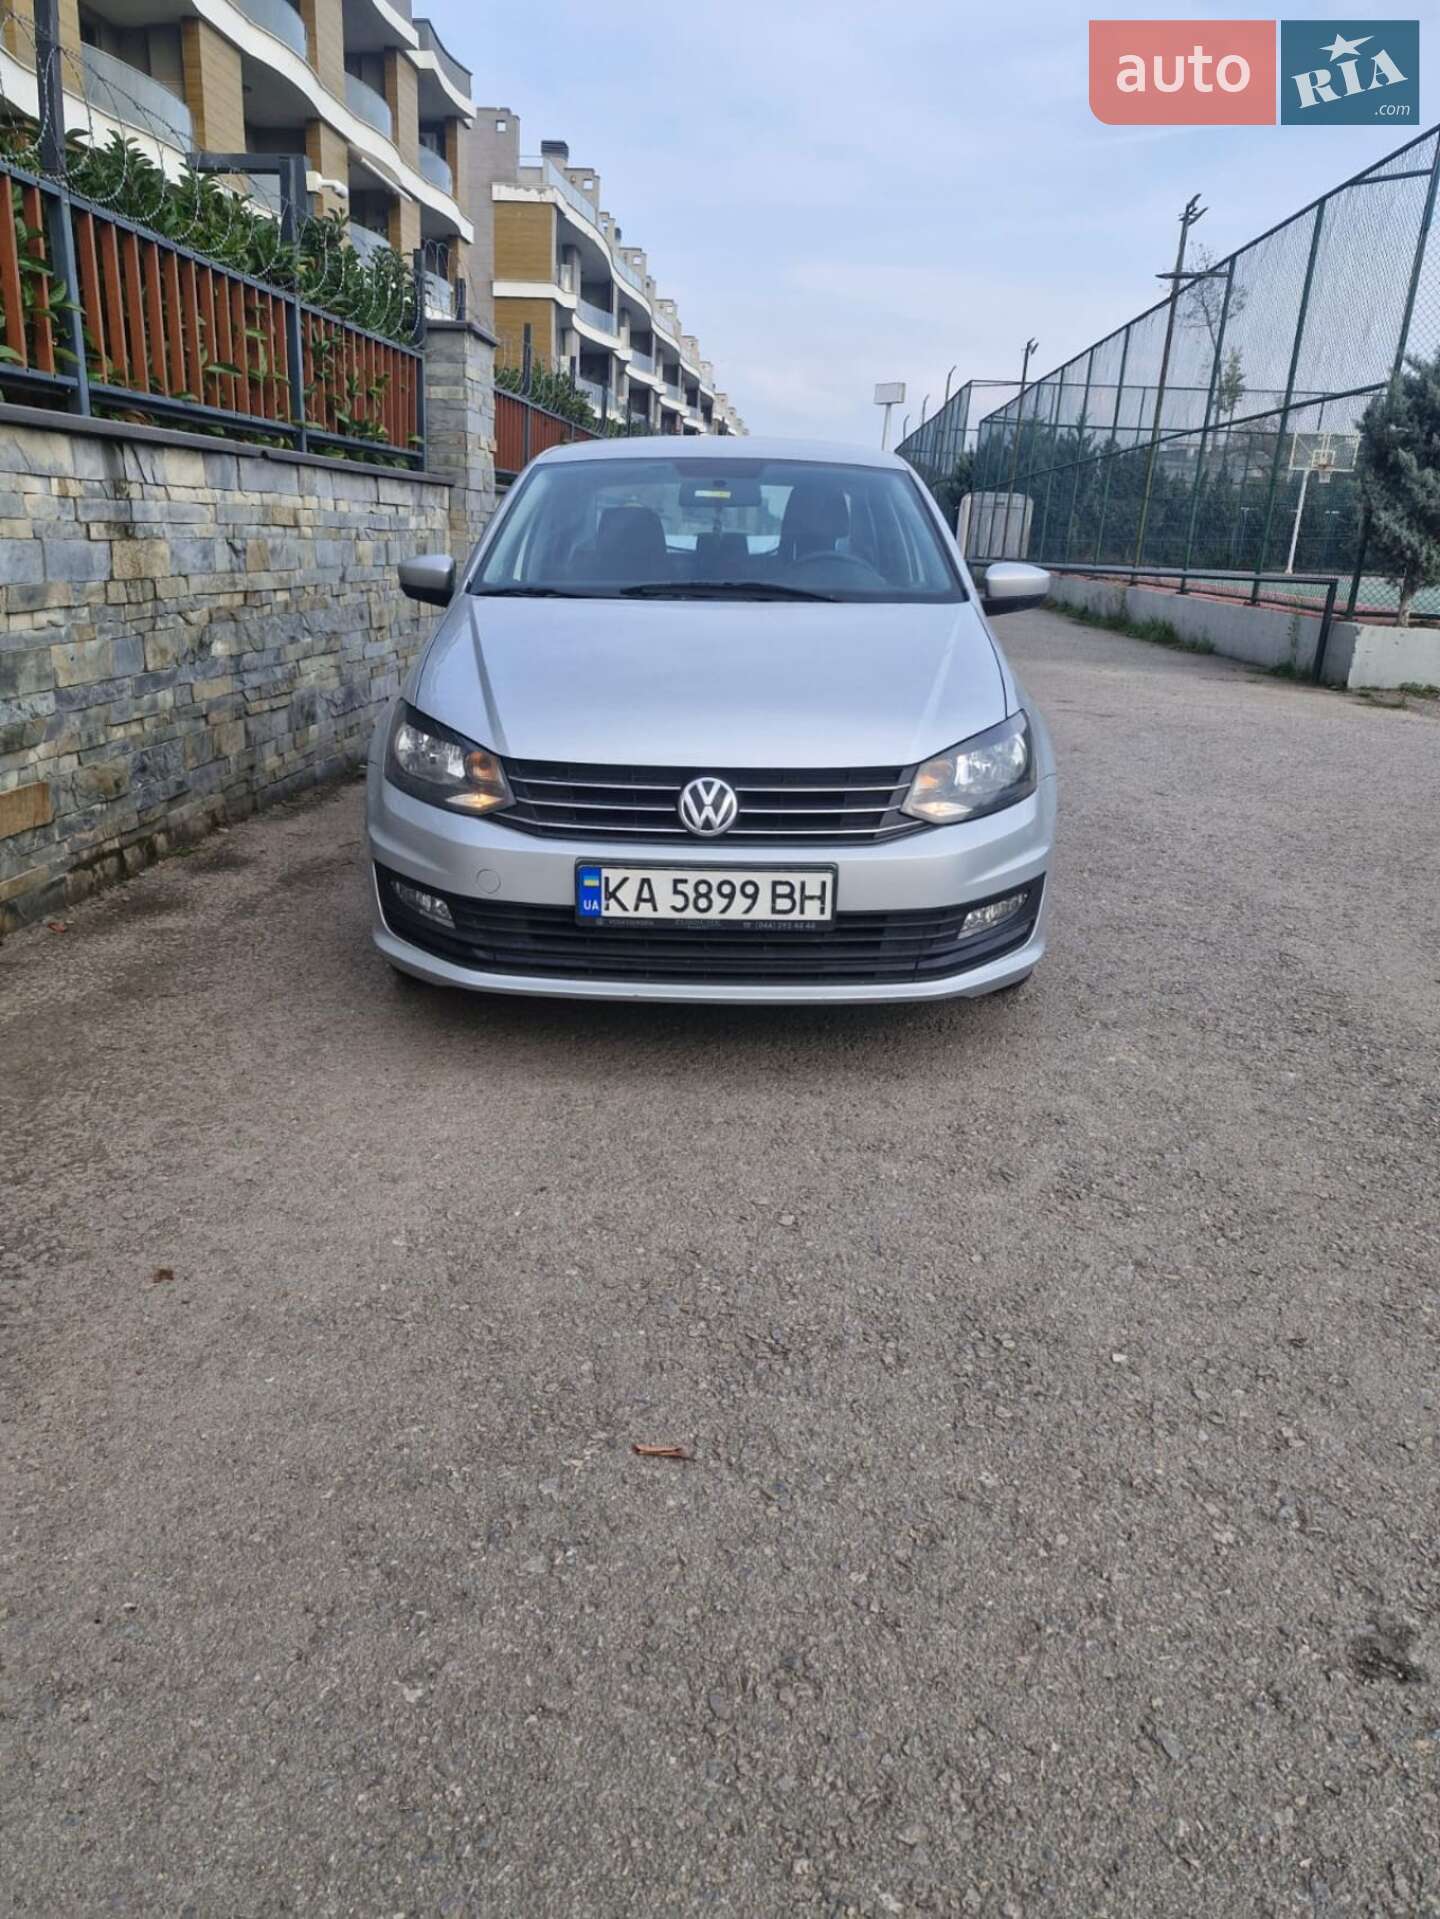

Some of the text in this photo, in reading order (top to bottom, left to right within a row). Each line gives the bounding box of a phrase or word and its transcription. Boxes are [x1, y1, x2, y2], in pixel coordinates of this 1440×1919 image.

[583, 899, 599, 911] UA
[603, 876, 826, 915] KA 5899 BH
